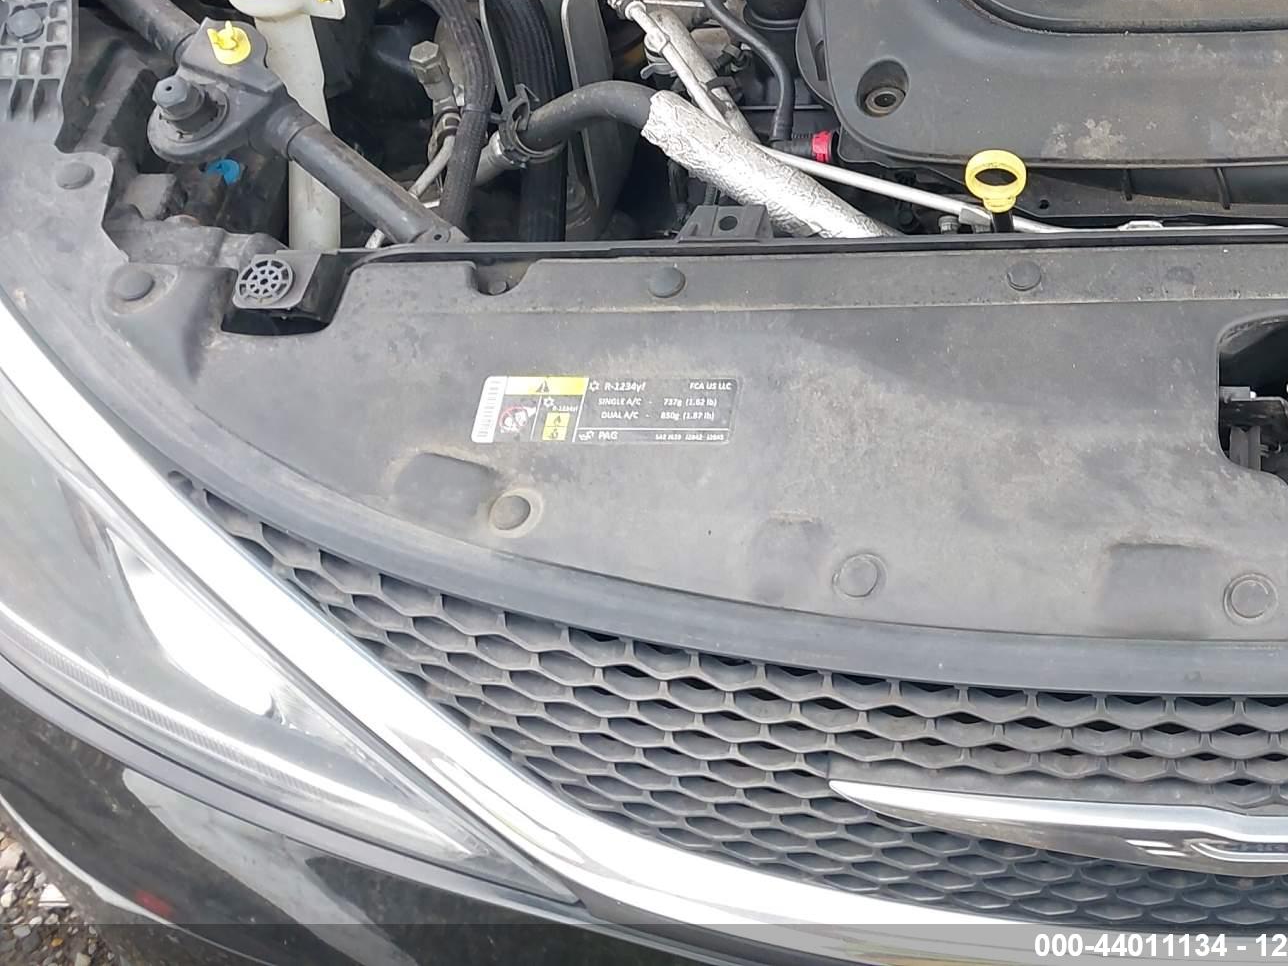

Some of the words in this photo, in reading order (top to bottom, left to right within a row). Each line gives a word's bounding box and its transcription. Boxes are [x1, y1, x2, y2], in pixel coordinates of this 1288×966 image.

[604, 382, 646, 392] R-1234yf
[690, 382, 704, 390] FCA
[706, 382, 717, 390] US
[718, 382, 732, 390] LLC
[598, 398, 625, 406] SINGLE
[626, 398, 642, 407] A/C
[623, 412, 639, 420] A/C
[598, 431, 618, 440] PAG
